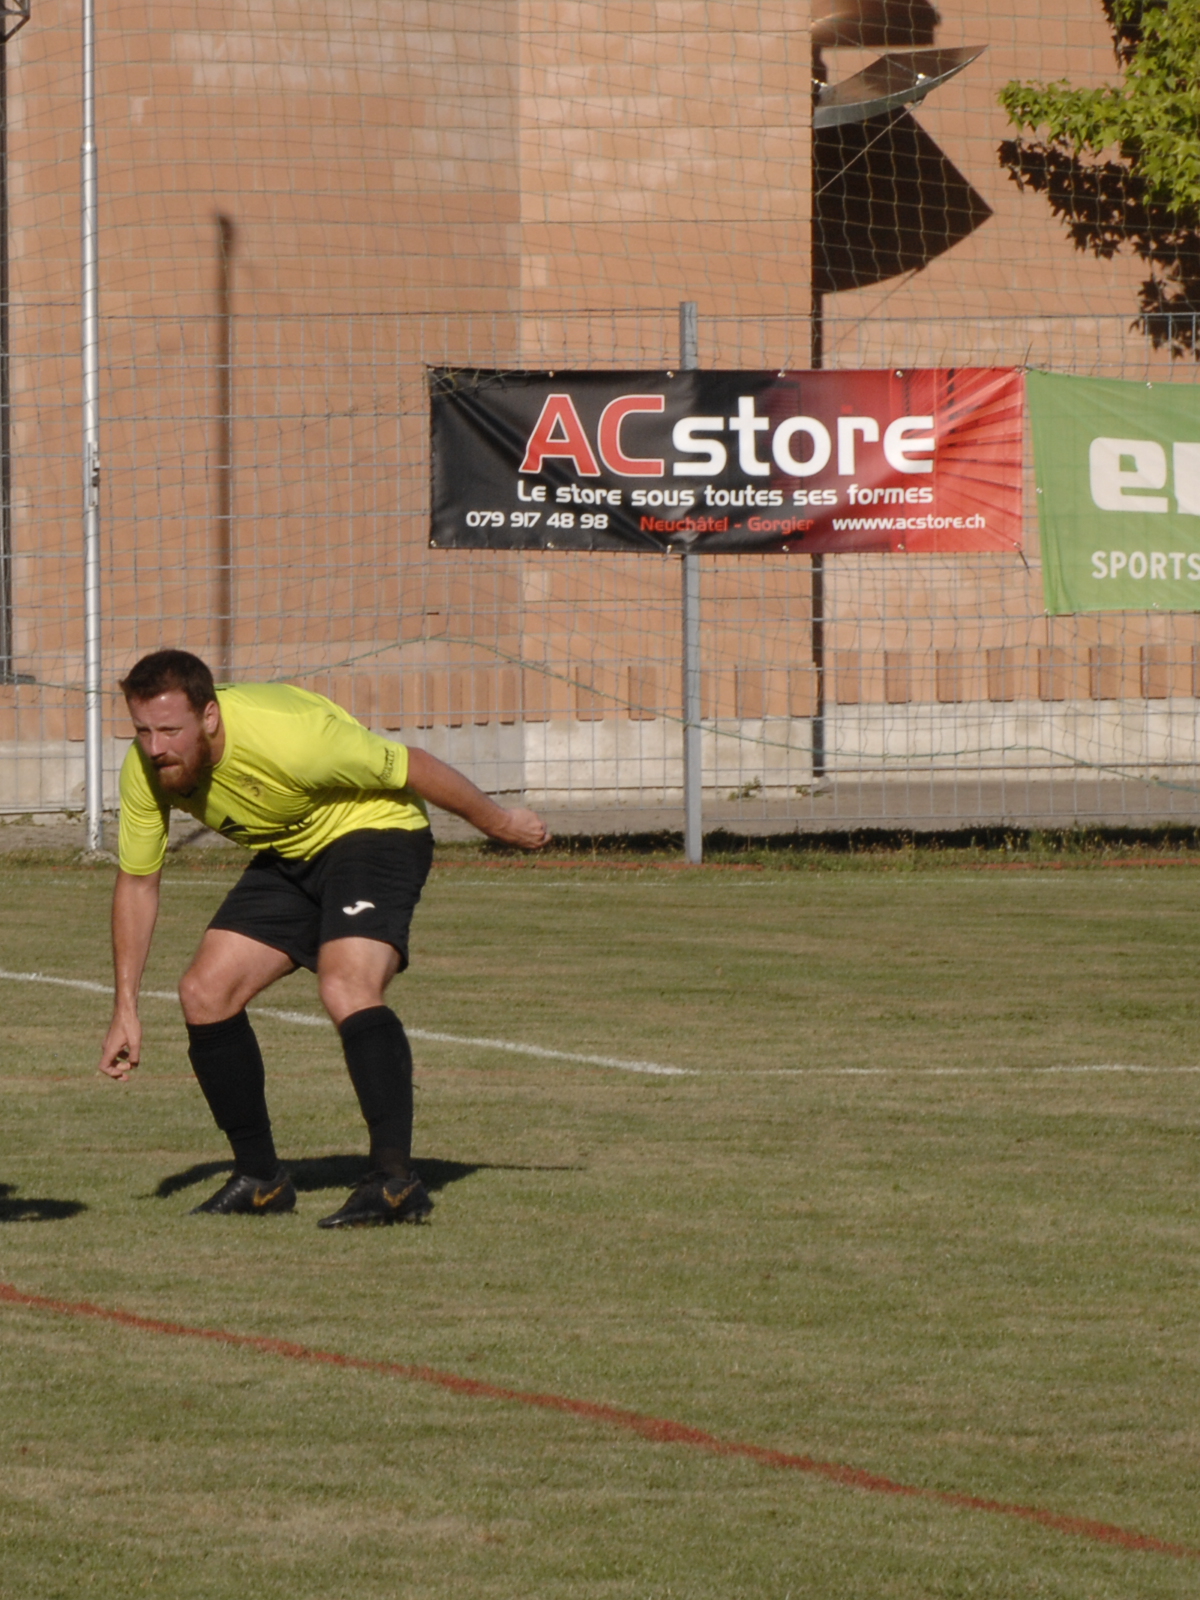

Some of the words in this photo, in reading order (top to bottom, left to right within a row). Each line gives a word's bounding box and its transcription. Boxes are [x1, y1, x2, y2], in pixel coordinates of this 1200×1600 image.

[517, 480, 547, 502] Le
[555, 483, 622, 506] store
[631, 489, 696, 507] sous
[704, 484, 783, 507] toutes
[793, 489, 837, 506] ses
[847, 483, 933, 506] formes
[466, 511, 504, 528] 079
[510, 511, 541, 529] 917
[546, 512, 574, 529] 48
[580, 513, 609, 530] 98
[640, 515, 729, 533] Neuchâtel
[746, 516, 814, 535] Gorgier
